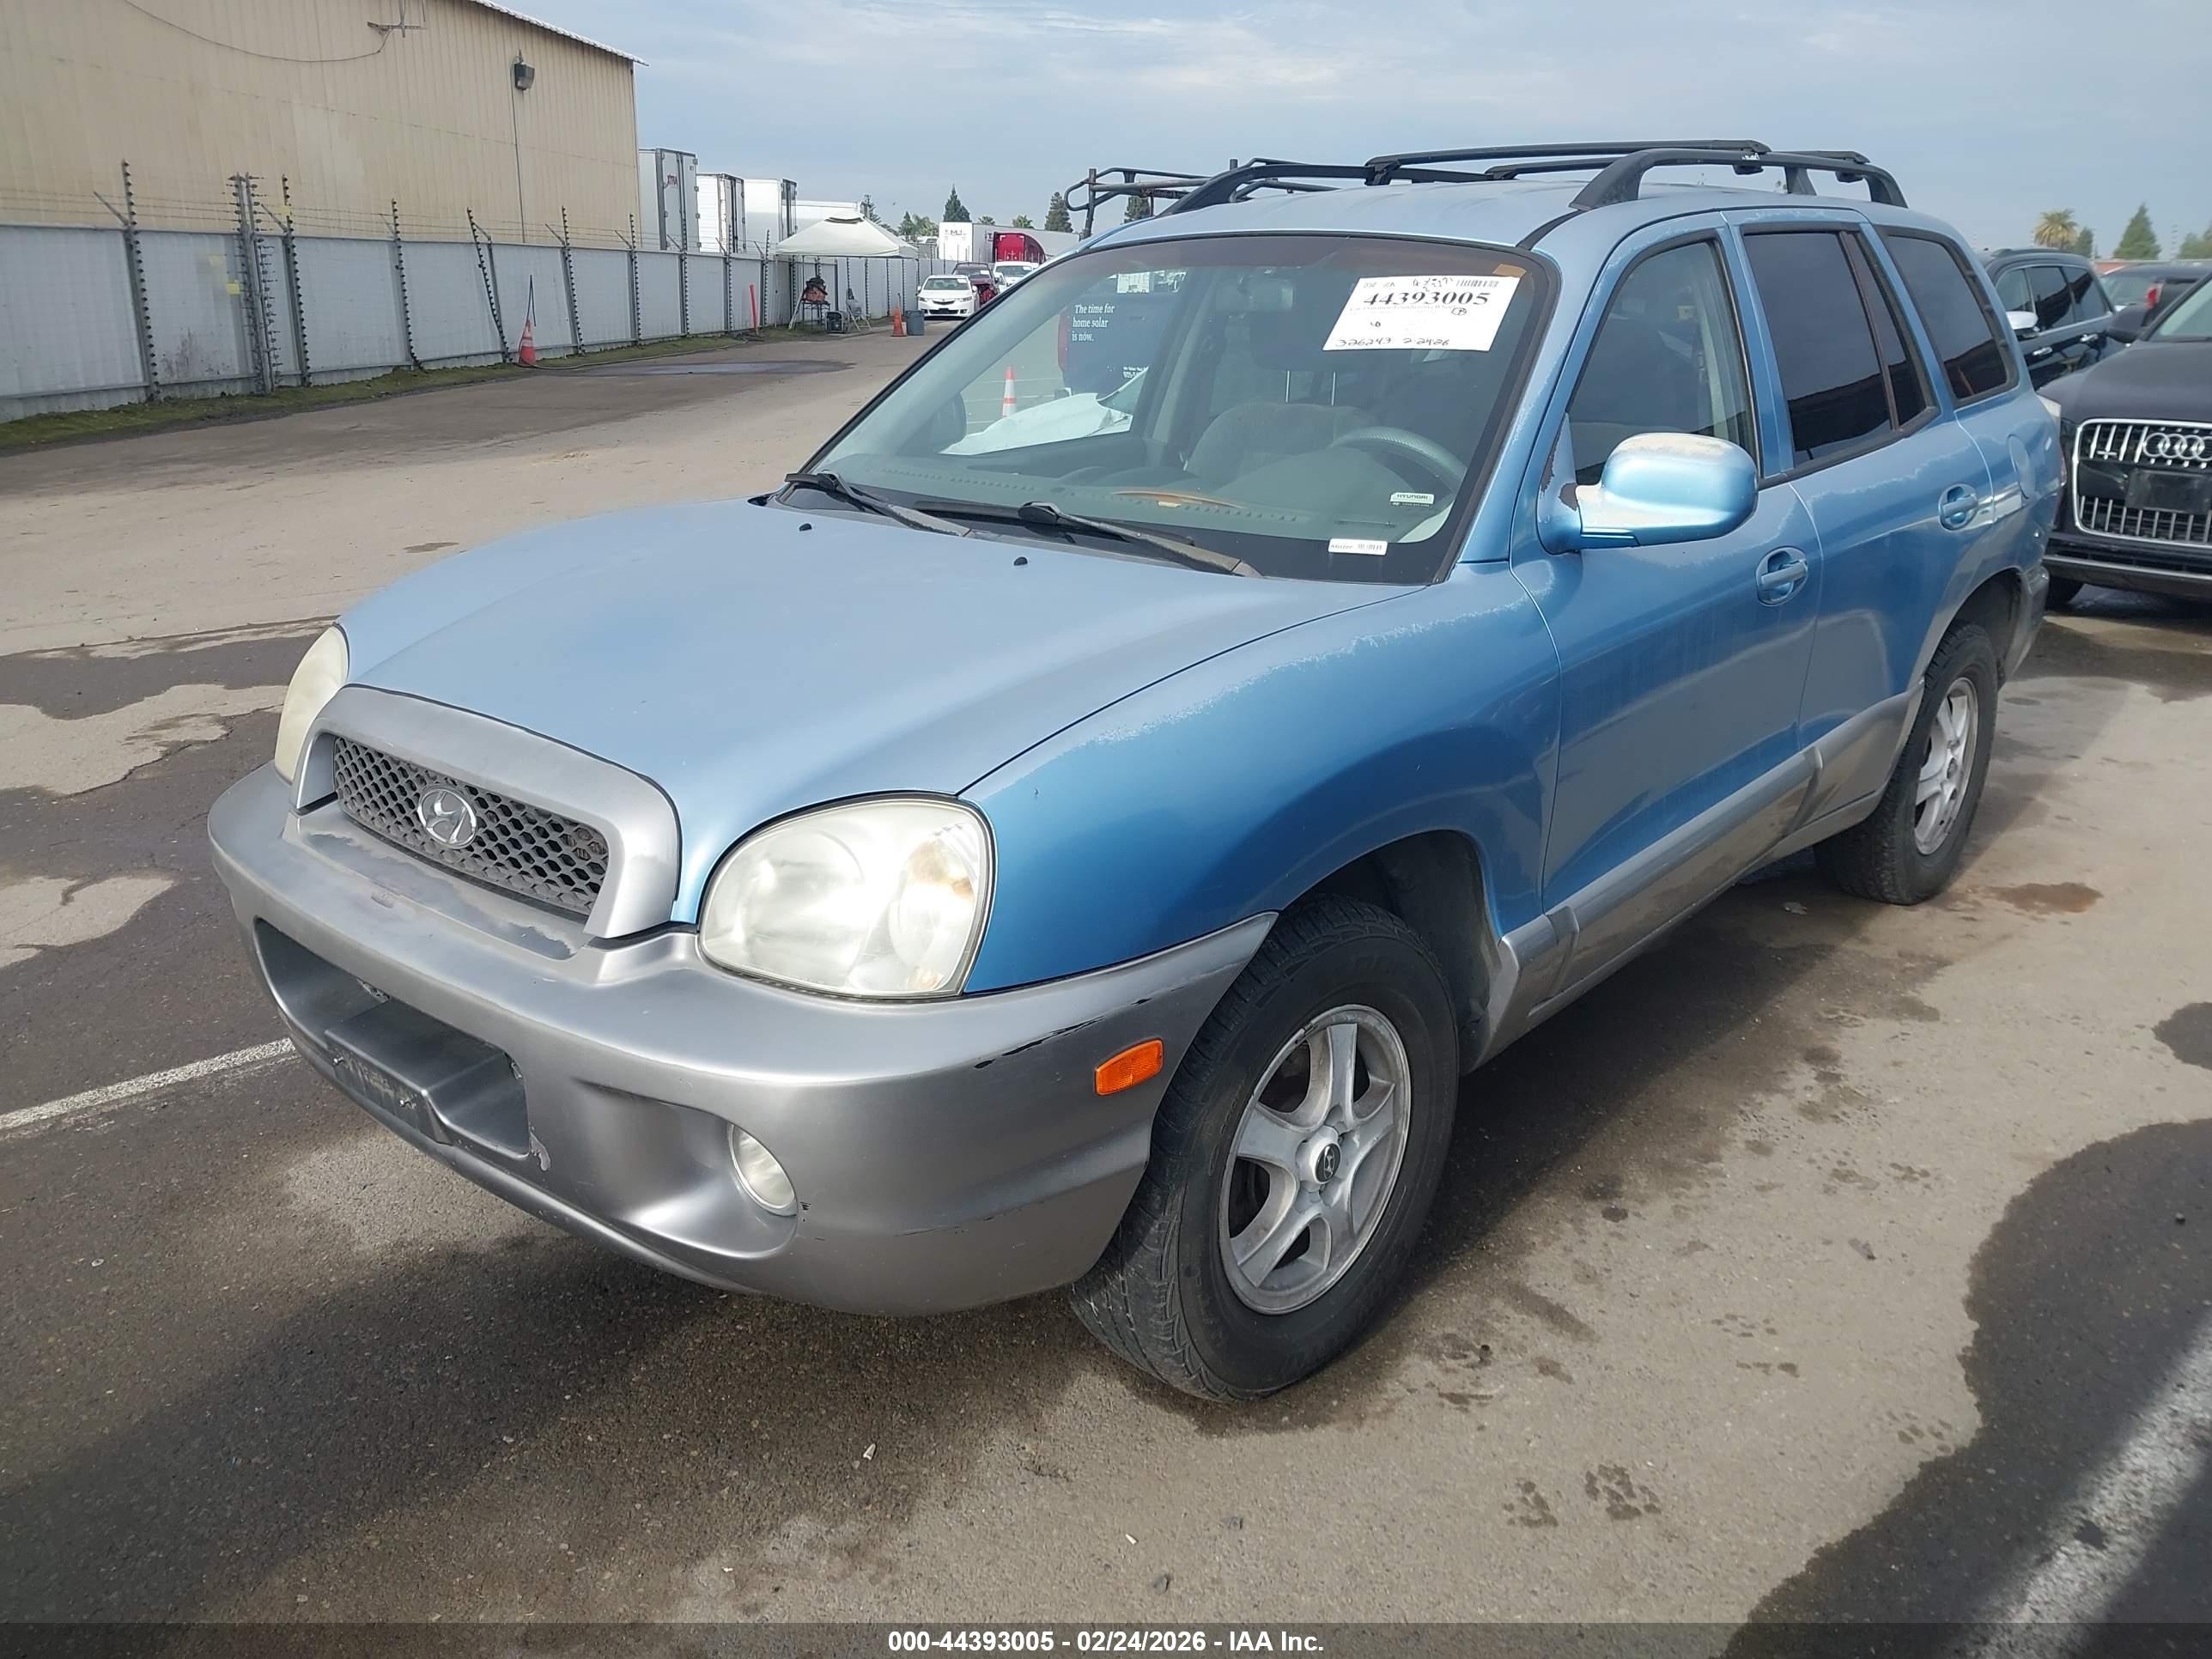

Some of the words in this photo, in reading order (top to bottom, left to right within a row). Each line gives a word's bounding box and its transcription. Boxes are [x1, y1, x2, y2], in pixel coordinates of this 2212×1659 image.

[1363, 291, 1492, 306] 44393005
[1074, 304, 1088, 313] The
[1088, 303, 1103, 313] time
[1103, 303, 1115, 313] for
[1073, 317, 1091, 328] home
[1091, 317, 1109, 328] solar
[1072, 331, 1078, 341] is
[1079, 332, 1094, 342] now.
